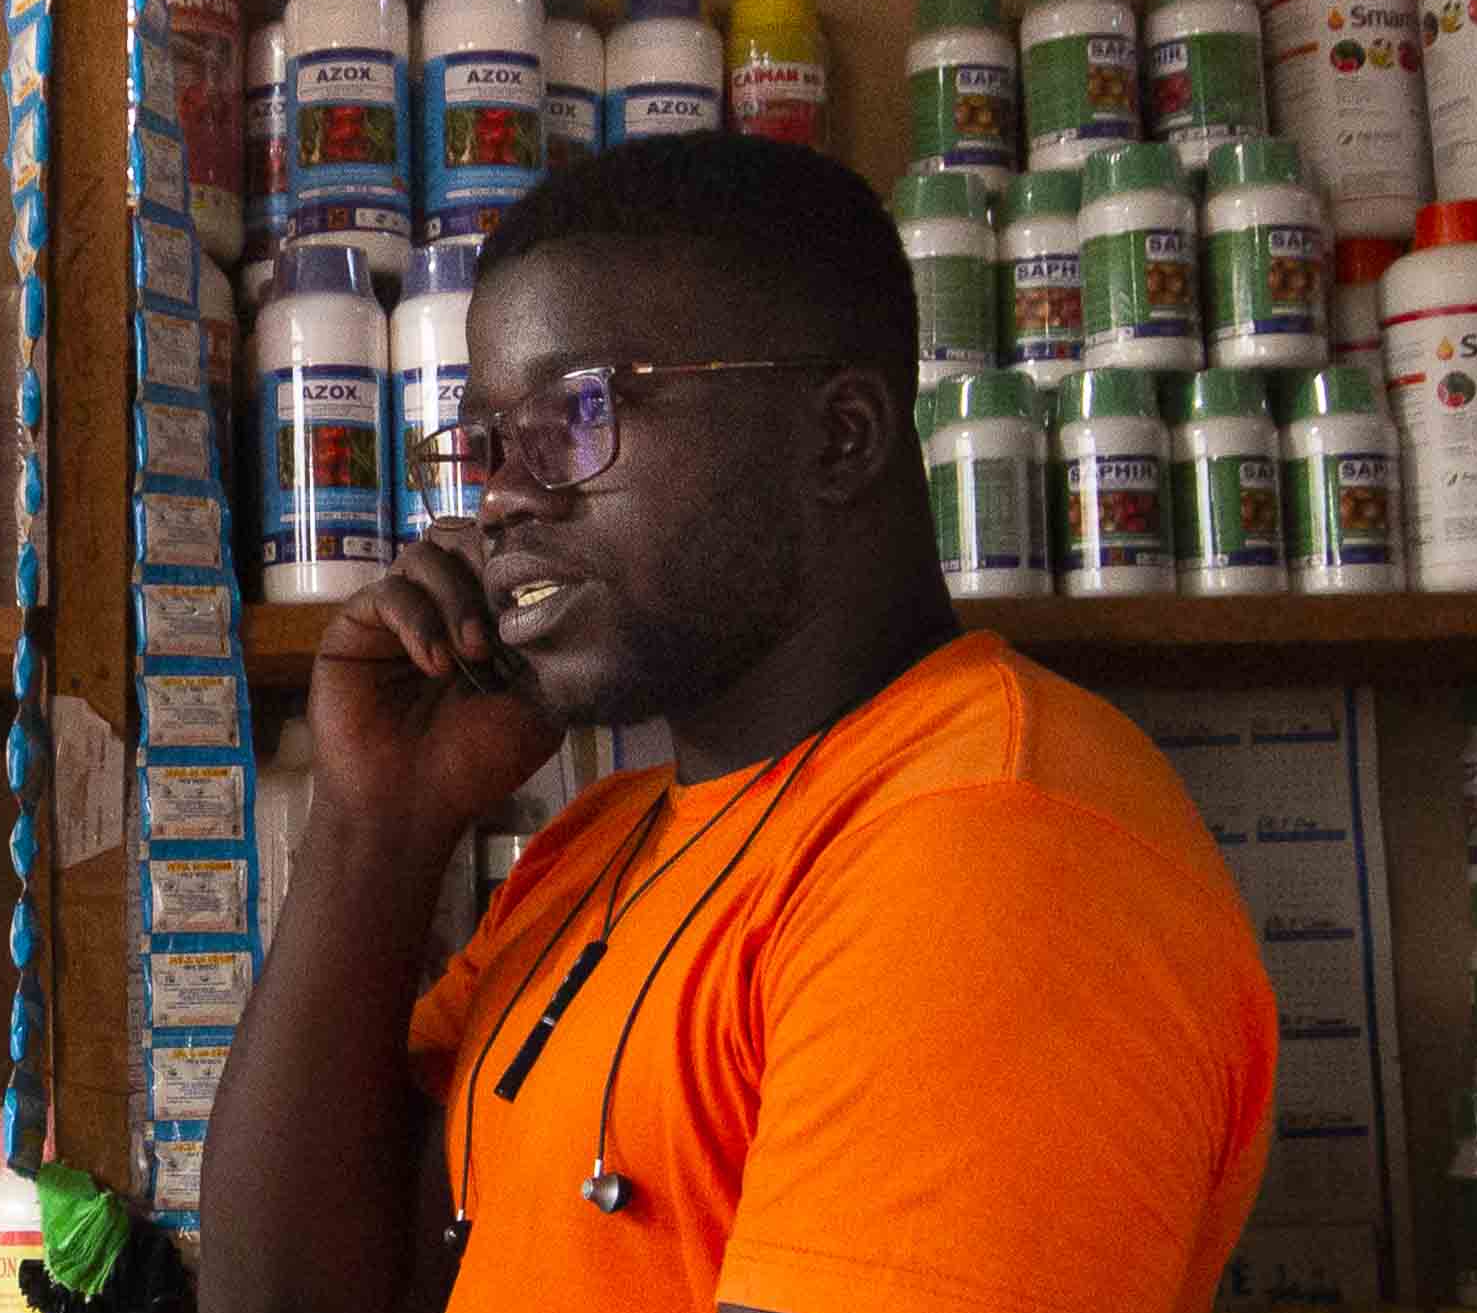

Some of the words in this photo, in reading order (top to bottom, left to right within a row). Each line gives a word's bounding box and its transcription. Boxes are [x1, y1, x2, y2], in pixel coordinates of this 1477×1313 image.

[316, 66, 372, 83] AZOX
[467, 68, 522, 84] AZOX
[648, 102, 702, 117] AZOX
[1017, 264, 1079, 283] SAPH
